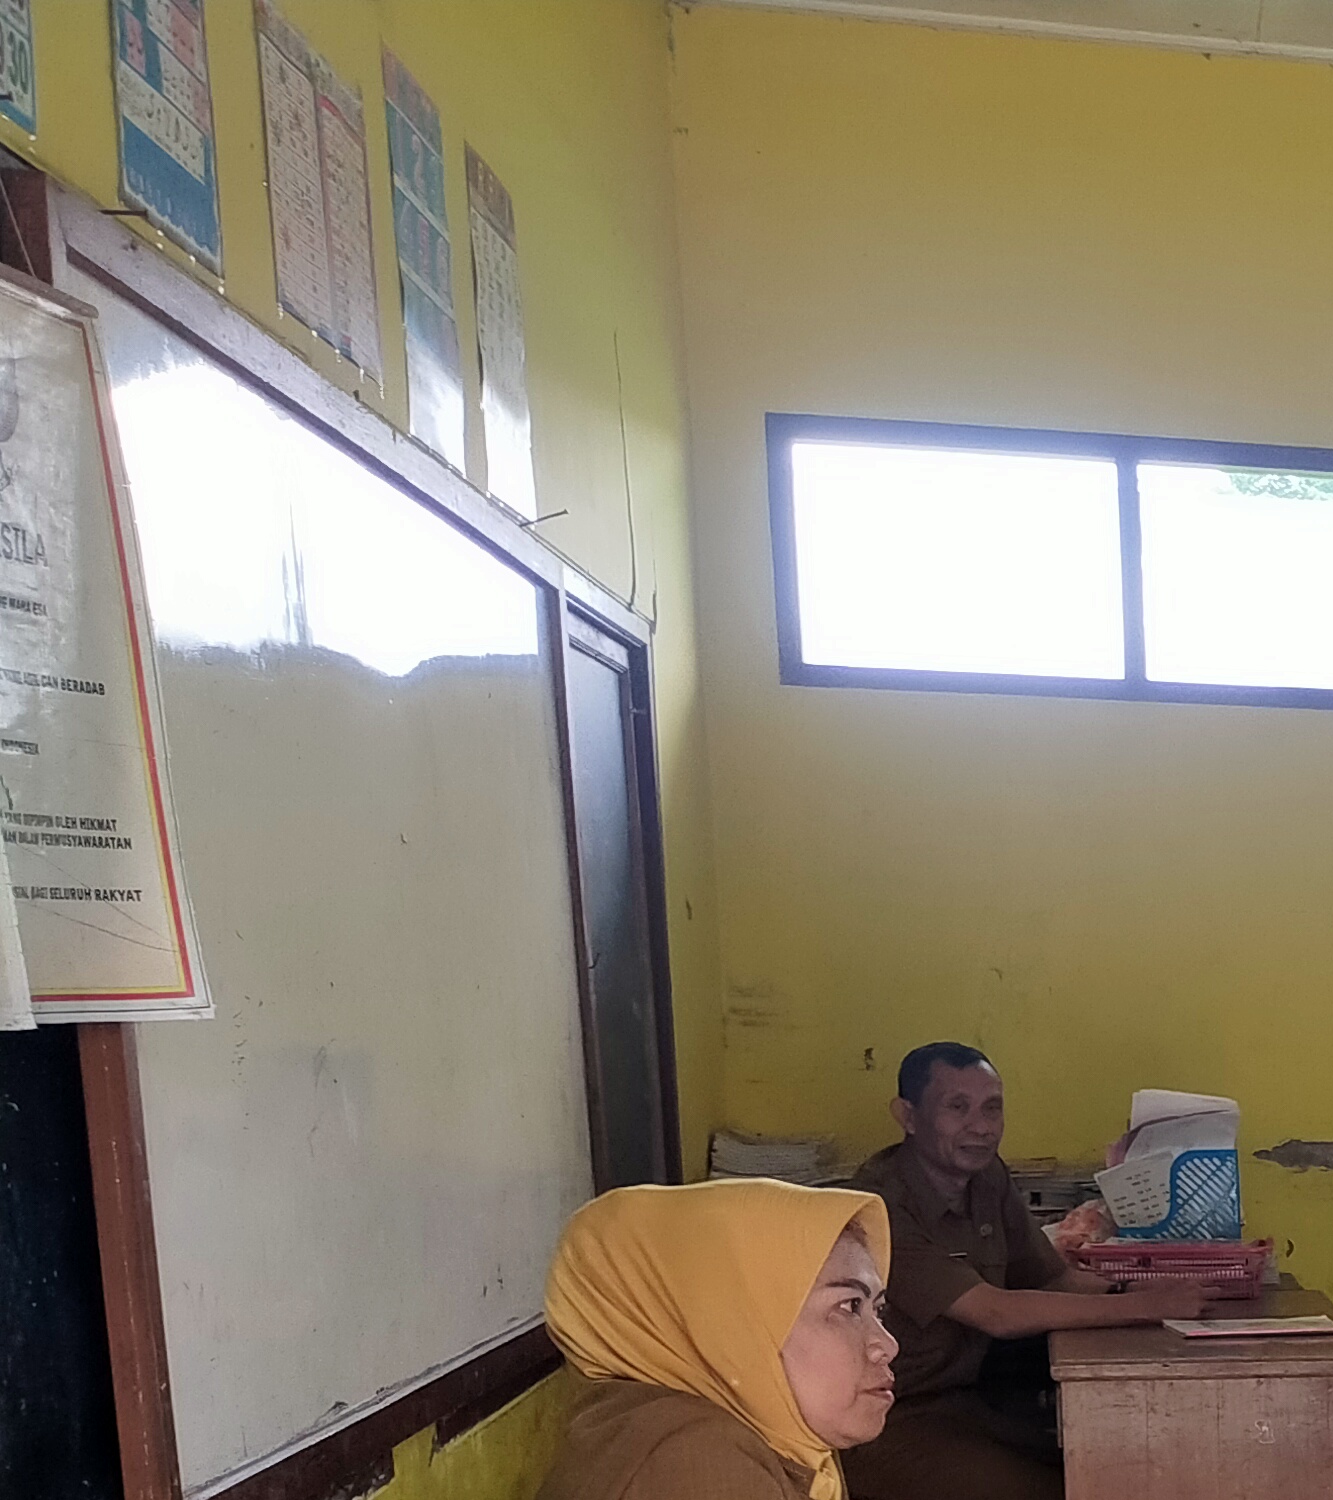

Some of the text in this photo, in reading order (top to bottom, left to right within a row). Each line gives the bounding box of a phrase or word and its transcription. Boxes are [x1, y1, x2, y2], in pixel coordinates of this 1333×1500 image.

[60, 677, 105, 696] BERADAB
[79, 817, 117, 832] HIKMAT
[94, 888, 143, 903] RAKYAT
